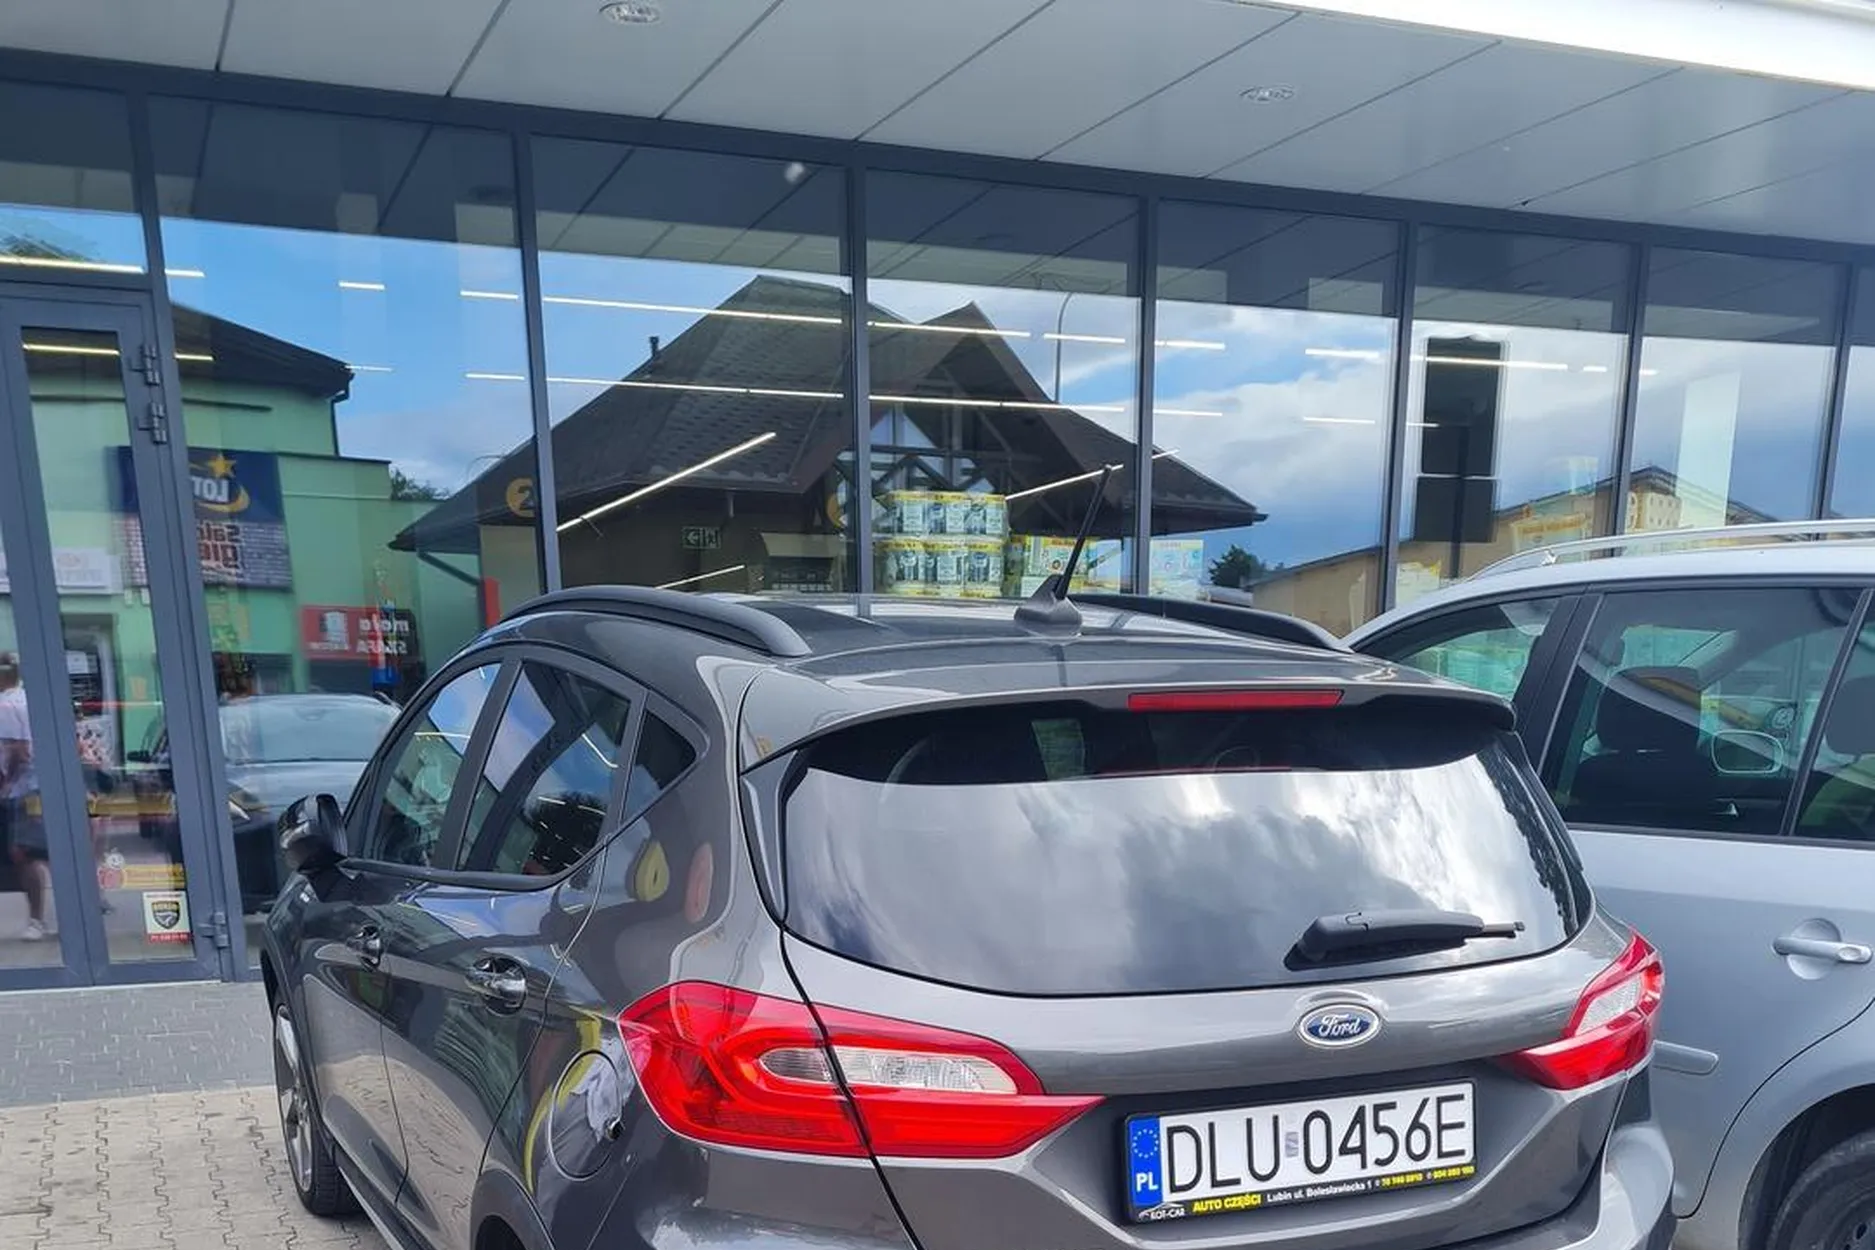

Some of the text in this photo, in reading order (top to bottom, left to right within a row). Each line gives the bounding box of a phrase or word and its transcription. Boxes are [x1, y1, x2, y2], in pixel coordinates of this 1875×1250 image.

[1318, 1013, 1362, 1037] Ford
[1166, 1094, 1466, 1193] DLU 0456E
[1136, 1172, 1158, 1192] PL
[1192, 1199, 1222, 1213] AUTO
[1225, 1193, 1262, 1210] CZĘŚCI
[1266, 1190, 1292, 1202] Lubin
